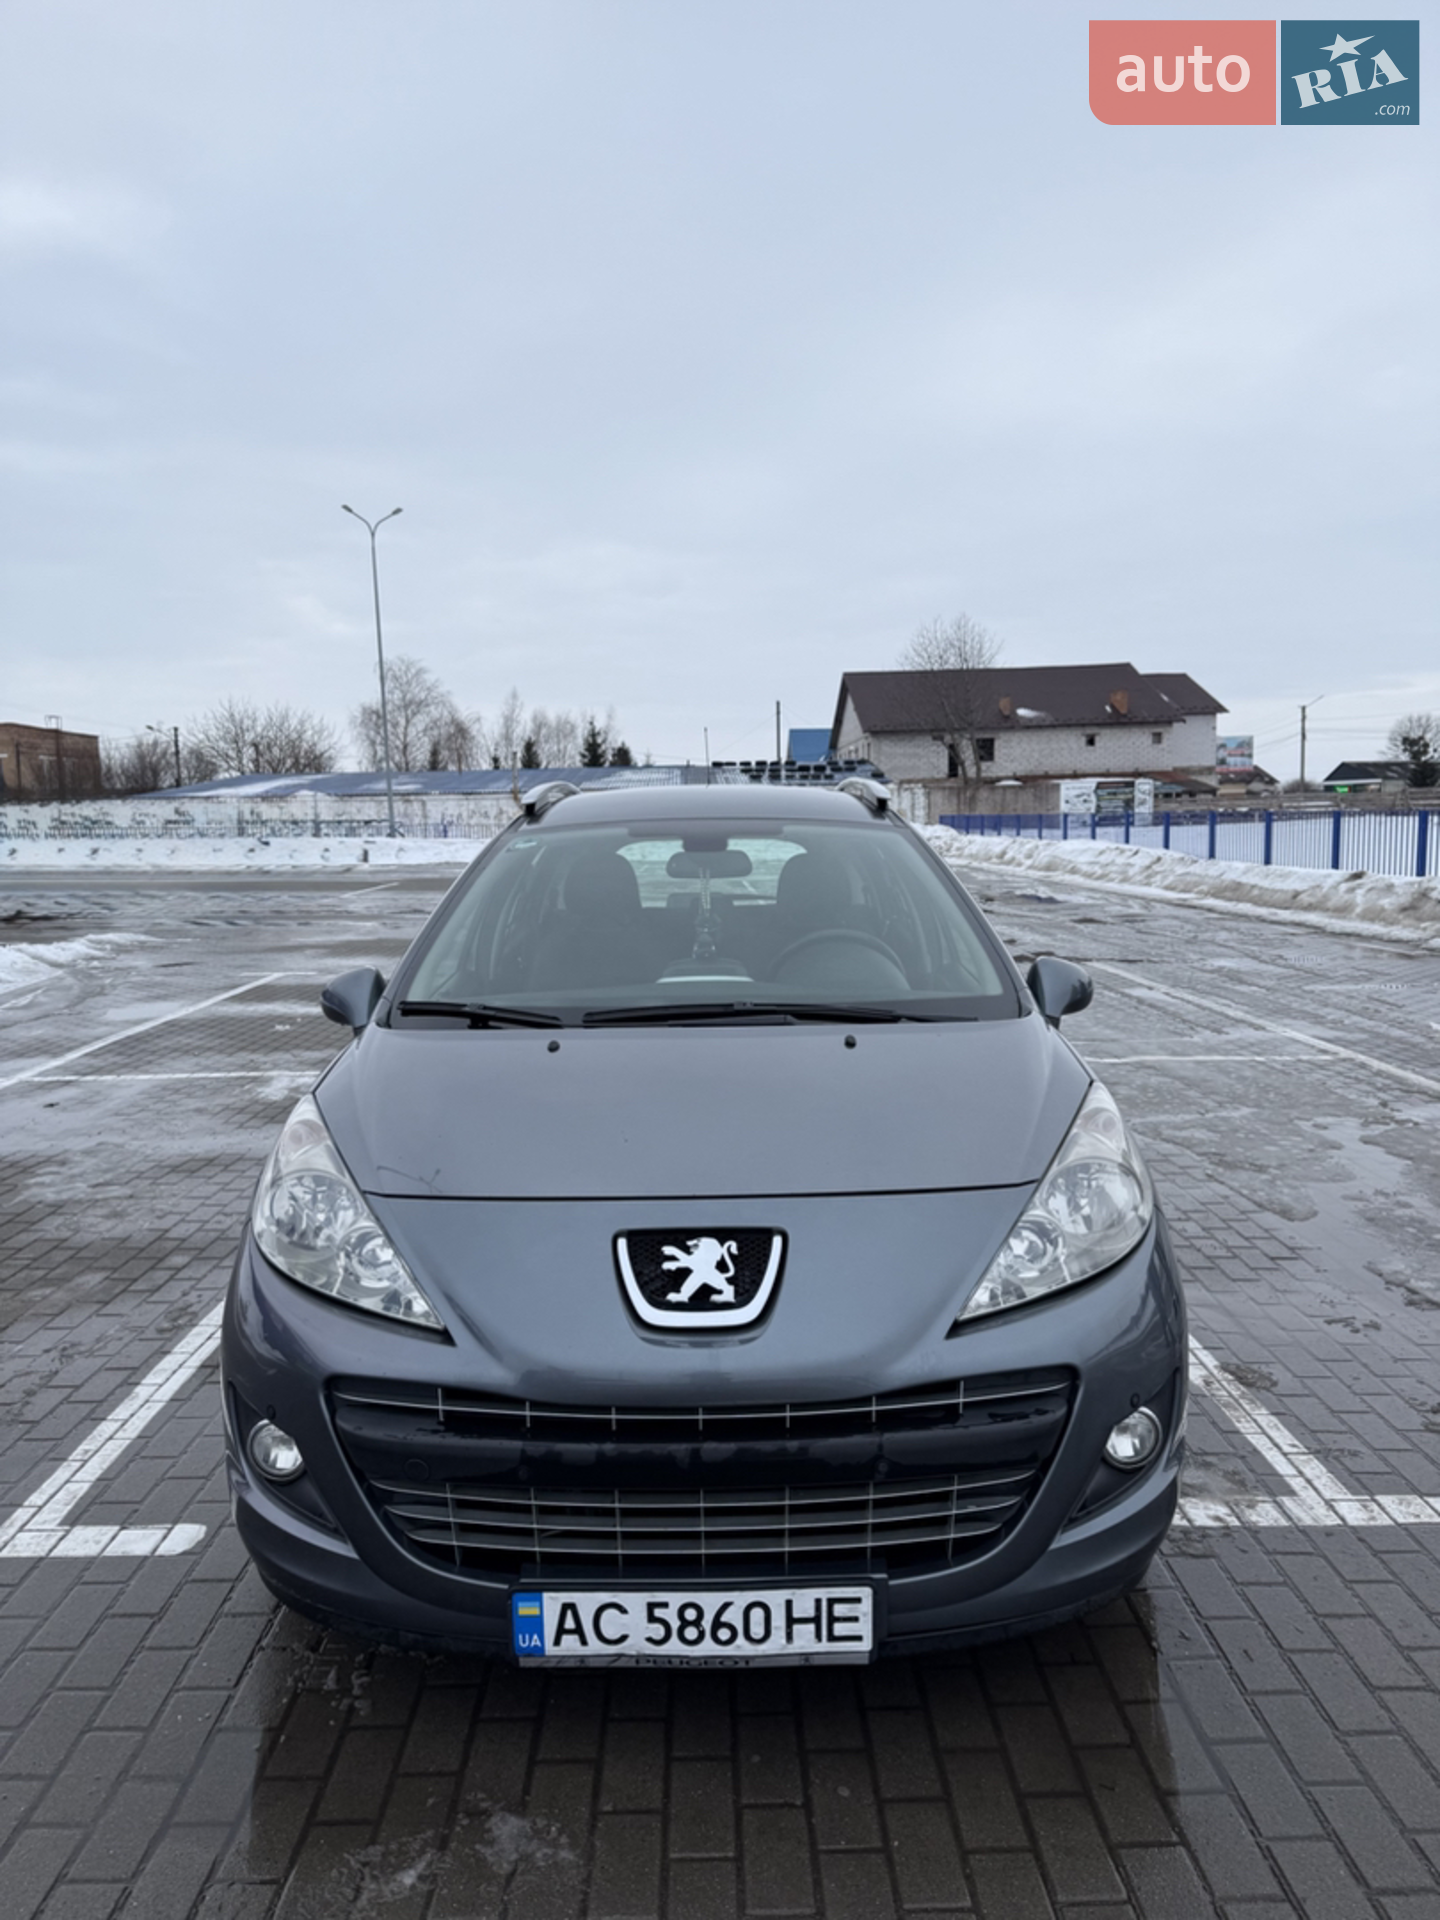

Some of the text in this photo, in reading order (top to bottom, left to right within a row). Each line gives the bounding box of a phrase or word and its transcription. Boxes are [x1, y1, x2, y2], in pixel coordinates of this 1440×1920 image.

[552, 1597, 864, 1647] AC 5860 HE
[518, 1633, 542, 1648] UA
